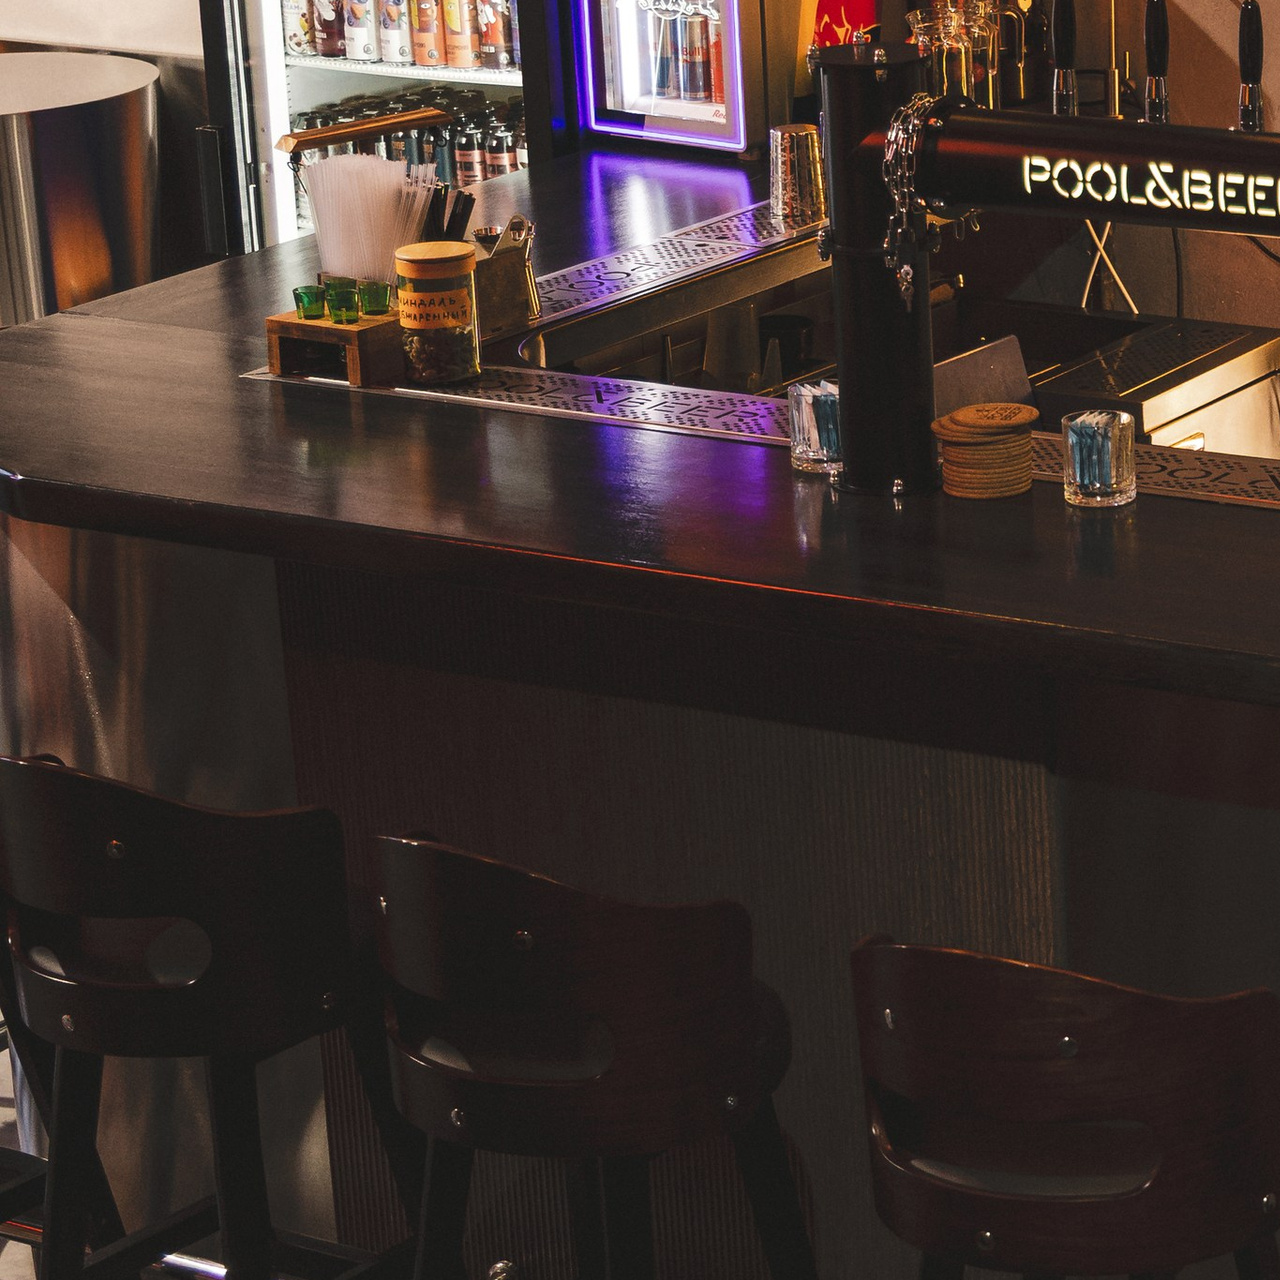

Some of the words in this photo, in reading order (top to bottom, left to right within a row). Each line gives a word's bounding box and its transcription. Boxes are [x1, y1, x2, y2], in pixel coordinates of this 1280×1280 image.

[682, 45, 700, 56] Bull
[400, 296, 456, 308] ИНДАЛЬ
[400, 304, 468, 323] БЖАРЕННЫЙ
